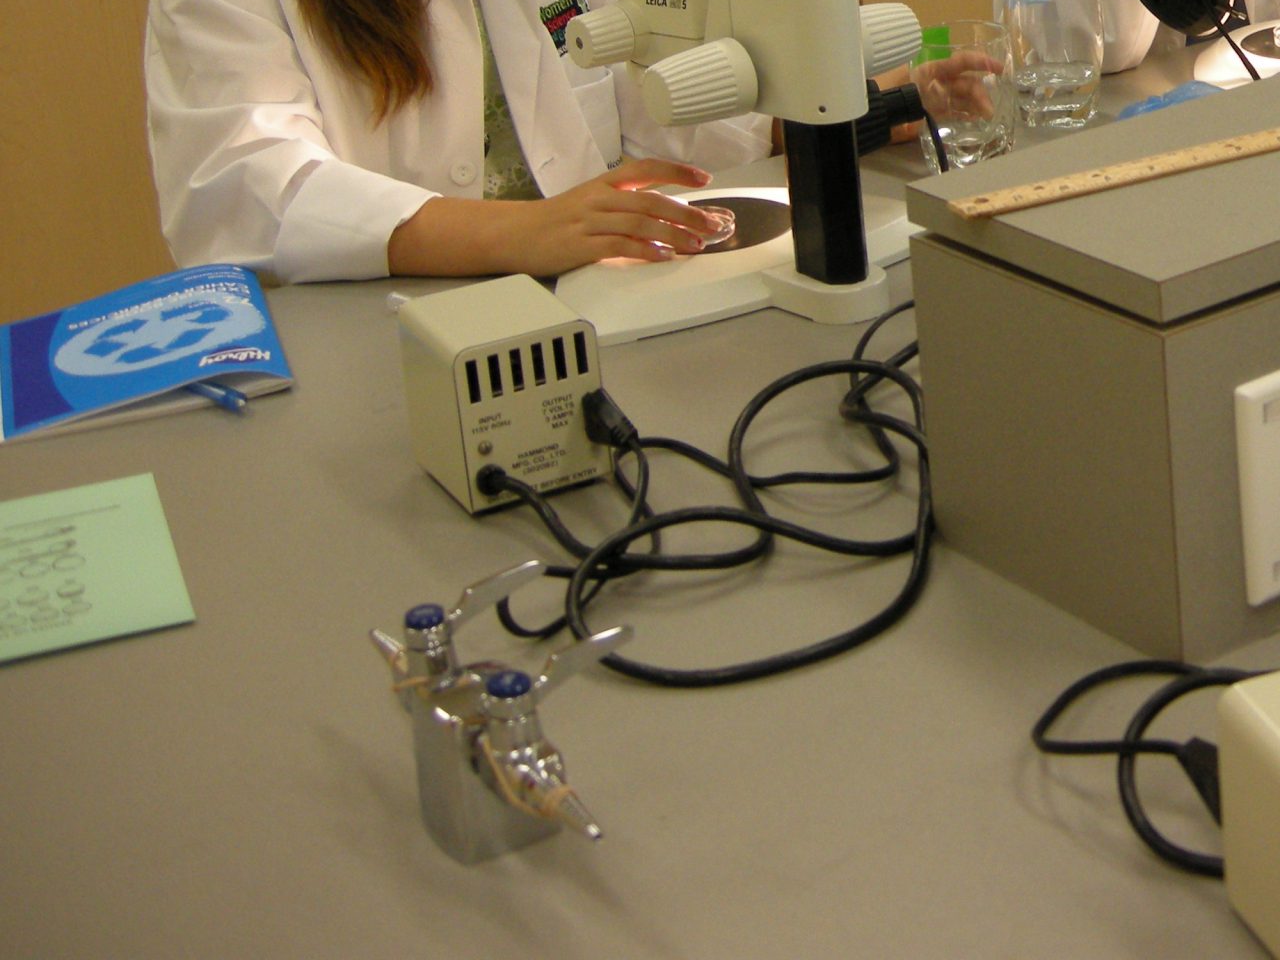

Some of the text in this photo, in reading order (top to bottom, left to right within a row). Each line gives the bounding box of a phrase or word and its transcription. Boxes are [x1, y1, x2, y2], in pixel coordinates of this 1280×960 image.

[542, 393, 573, 408] OUTPUT
[549, 401, 575, 414] VOLTS
[478, 412, 502, 425] INPUT
[551, 409, 574, 422] AMPS
[551, 420, 569, 430] MAX
[517, 442, 559, 459] HAMMOND
[572, 466, 598, 479] ENTRY
